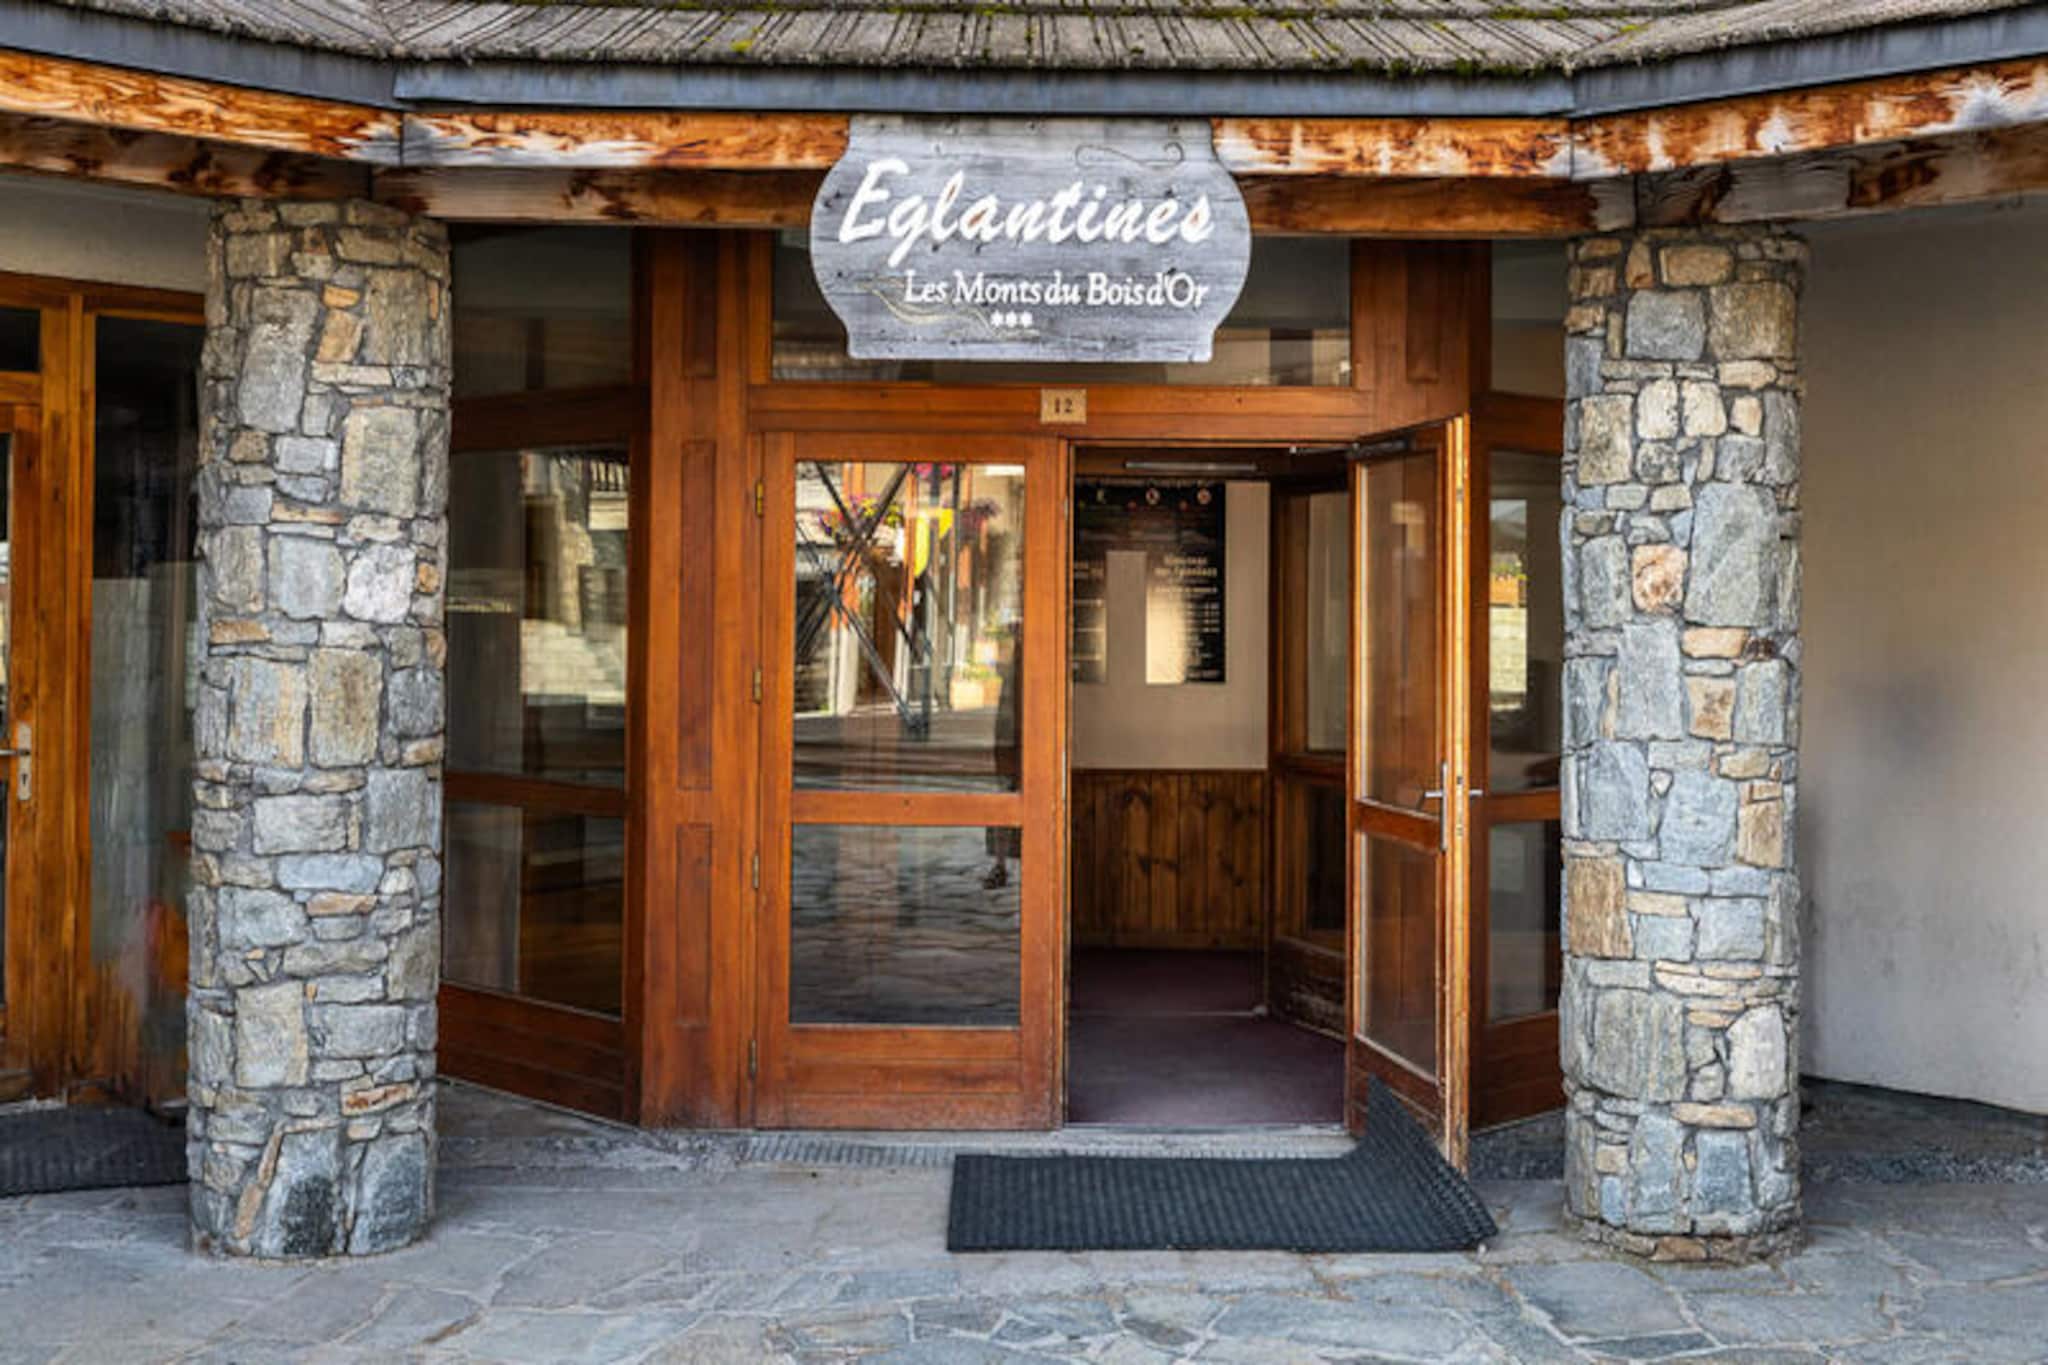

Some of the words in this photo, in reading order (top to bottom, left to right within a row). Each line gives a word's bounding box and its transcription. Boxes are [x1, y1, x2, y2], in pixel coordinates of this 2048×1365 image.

[839, 158, 1214, 268] Eglantines
[904, 269, 948, 303] Les
[952, 270, 1042, 304] Monts
[1044, 271, 1082, 305] du
[1086, 272, 1144, 306] Bois
[1145, 272, 1209, 308] d'Or
[1055, 397, 1073, 414] 12
